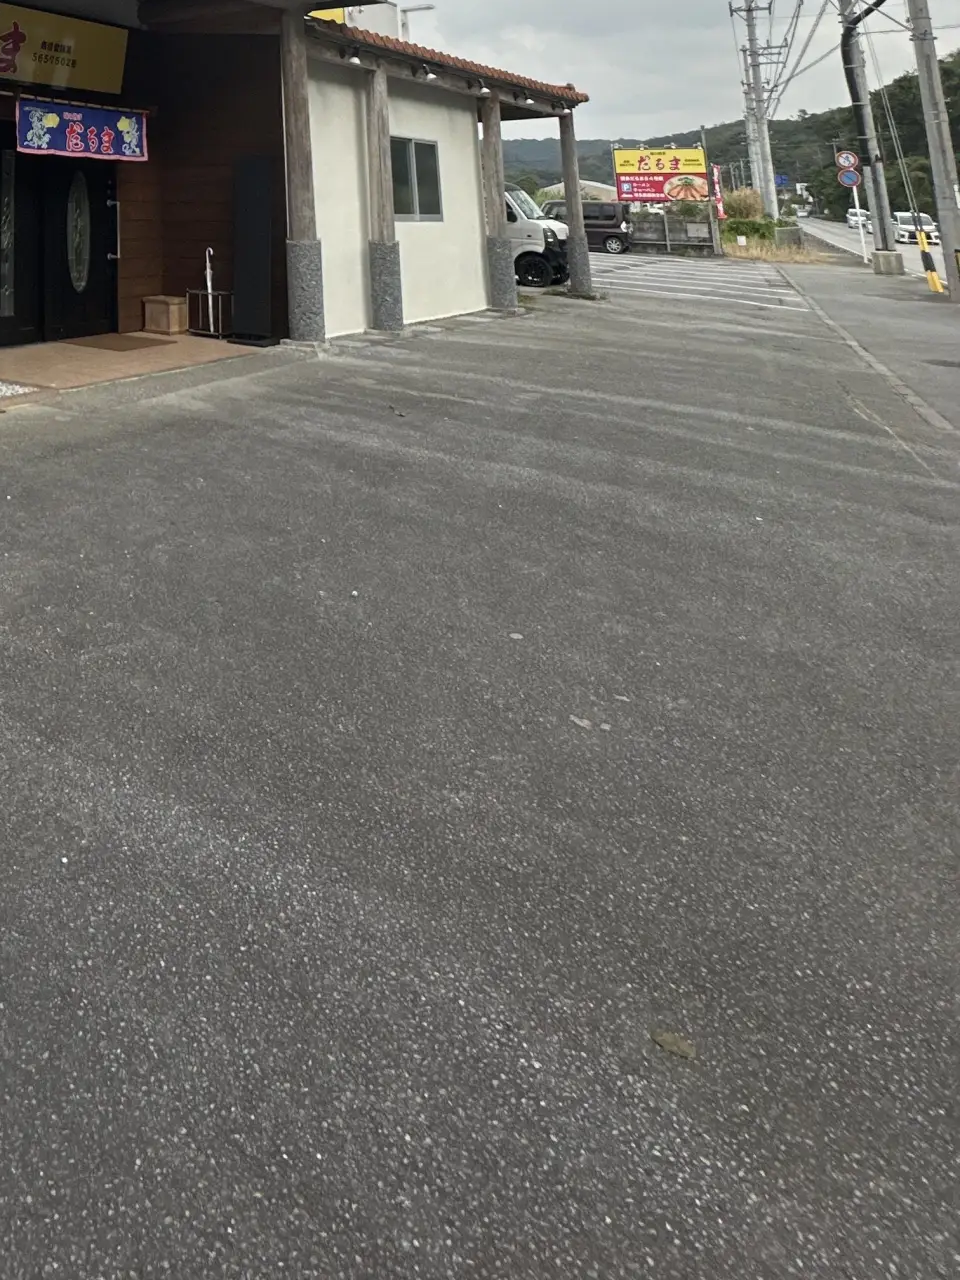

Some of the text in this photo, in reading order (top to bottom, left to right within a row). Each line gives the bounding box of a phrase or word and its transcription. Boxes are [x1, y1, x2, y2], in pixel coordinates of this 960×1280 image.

[65, 121, 115, 154] だるま
[637, 155, 681, 171] だるま
